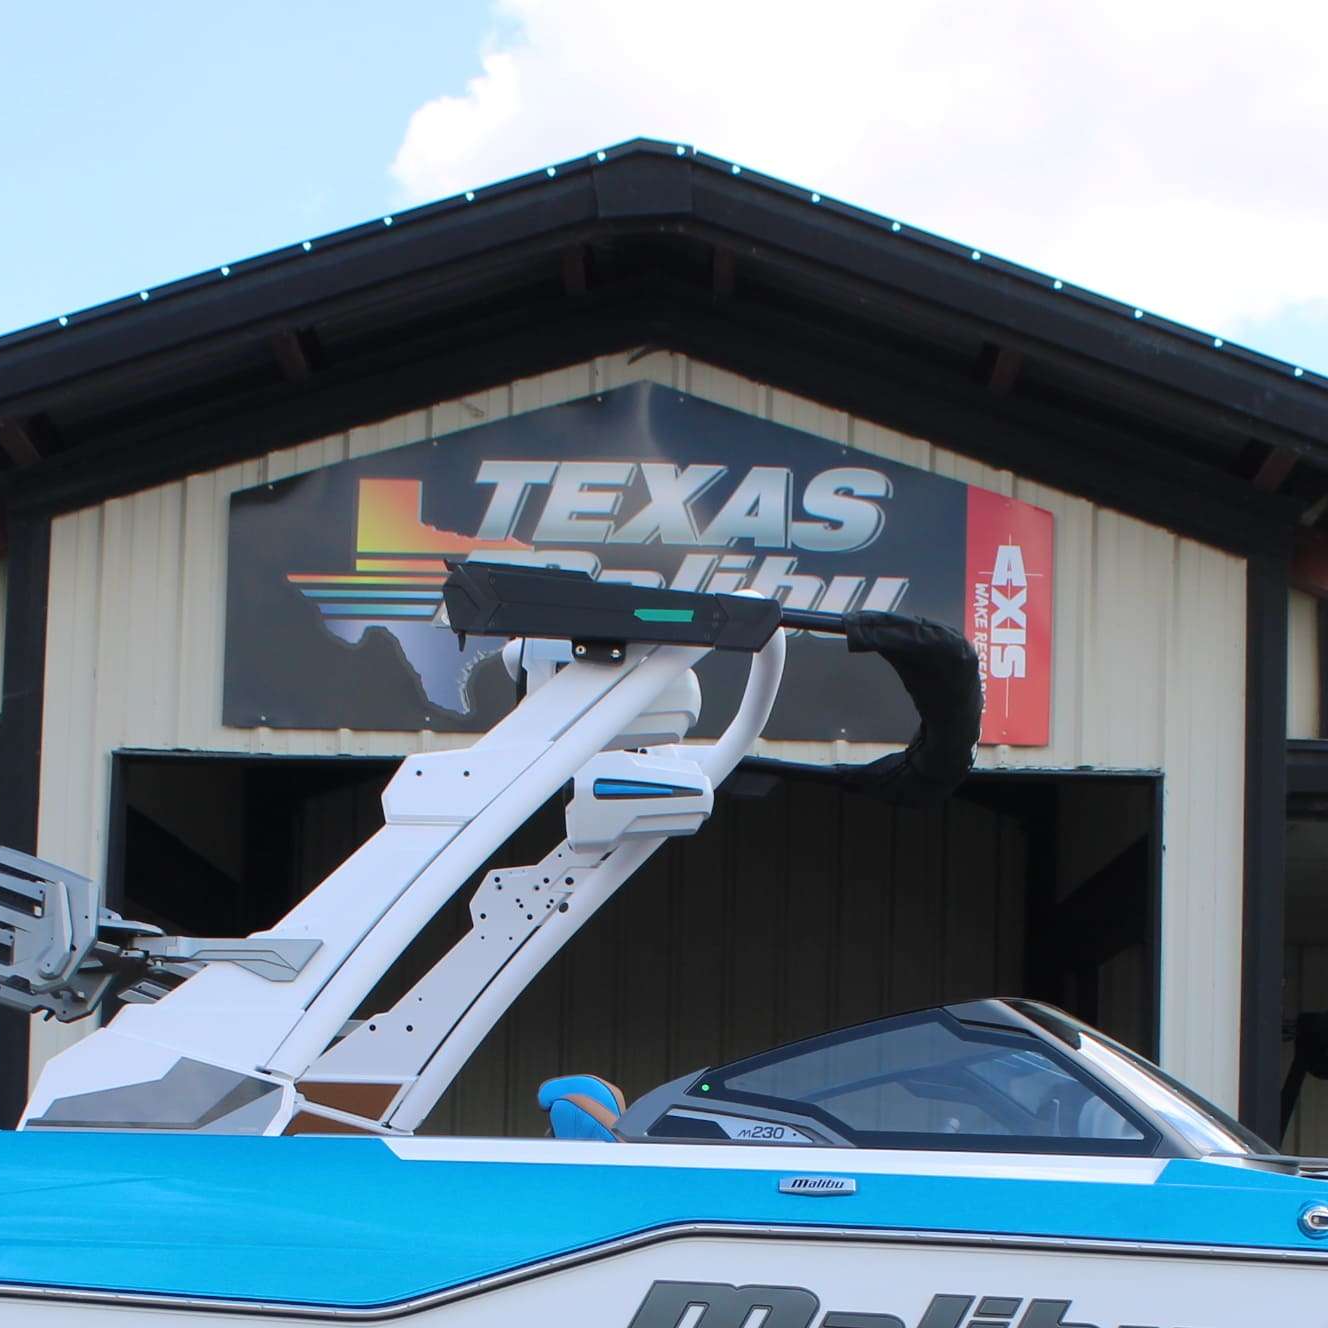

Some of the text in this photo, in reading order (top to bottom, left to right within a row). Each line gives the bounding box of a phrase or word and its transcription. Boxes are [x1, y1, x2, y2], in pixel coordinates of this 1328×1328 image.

[474, 459, 894, 553] TEXAS
[974, 582, 989, 629] WAKE
[990, 544, 1028, 679] AXIS
[790, 1178, 845, 1189] Malibu
